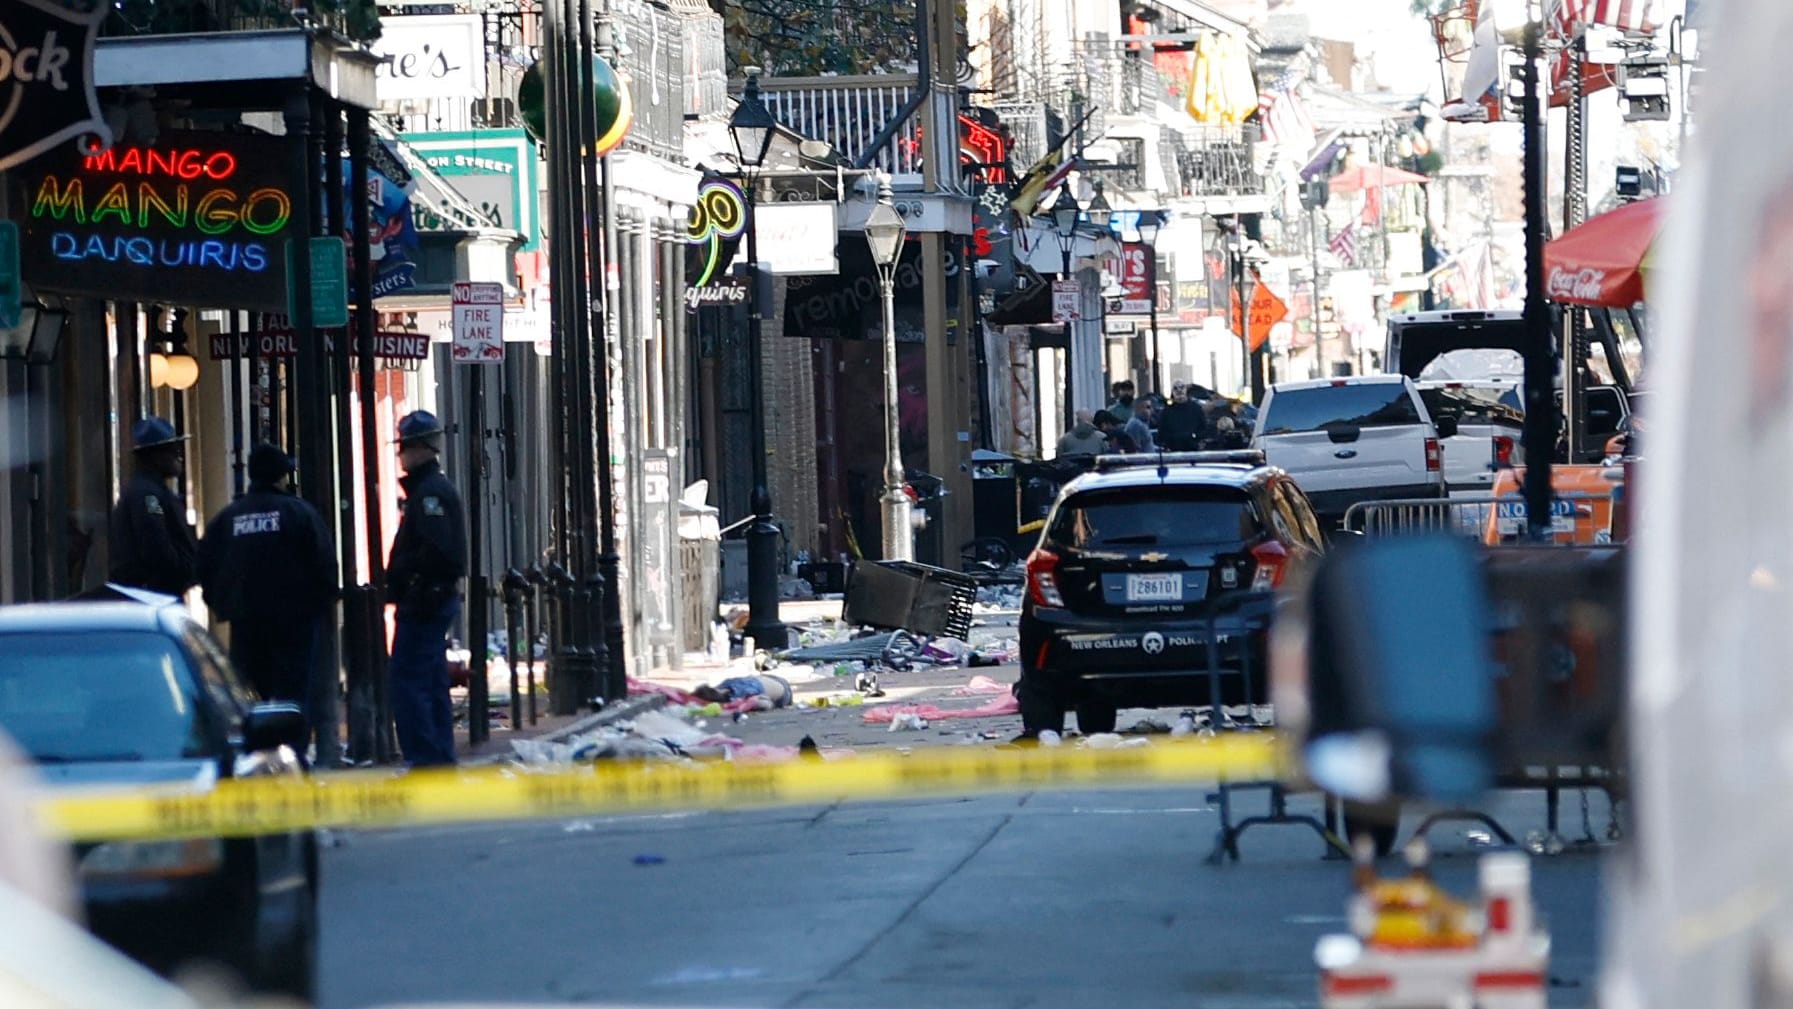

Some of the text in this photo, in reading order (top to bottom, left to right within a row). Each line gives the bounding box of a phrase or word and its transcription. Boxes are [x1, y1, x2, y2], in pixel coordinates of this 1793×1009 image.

[85, 143, 236, 180] MANGO
[454, 154, 514, 174] STREET
[32, 175, 291, 234] MANGO
[52, 232, 268, 271] DAIQUIRIS
[453, 285, 471, 302] NO
[684, 281, 747, 310] quiris
[464, 309, 491, 322] FIRE
[462, 326, 493, 340] LANE
[233, 518, 280, 536] POLICE
[1137, 580, 1178, 594] 286101
[1070, 638, 1138, 650] NEW ORLEANS
